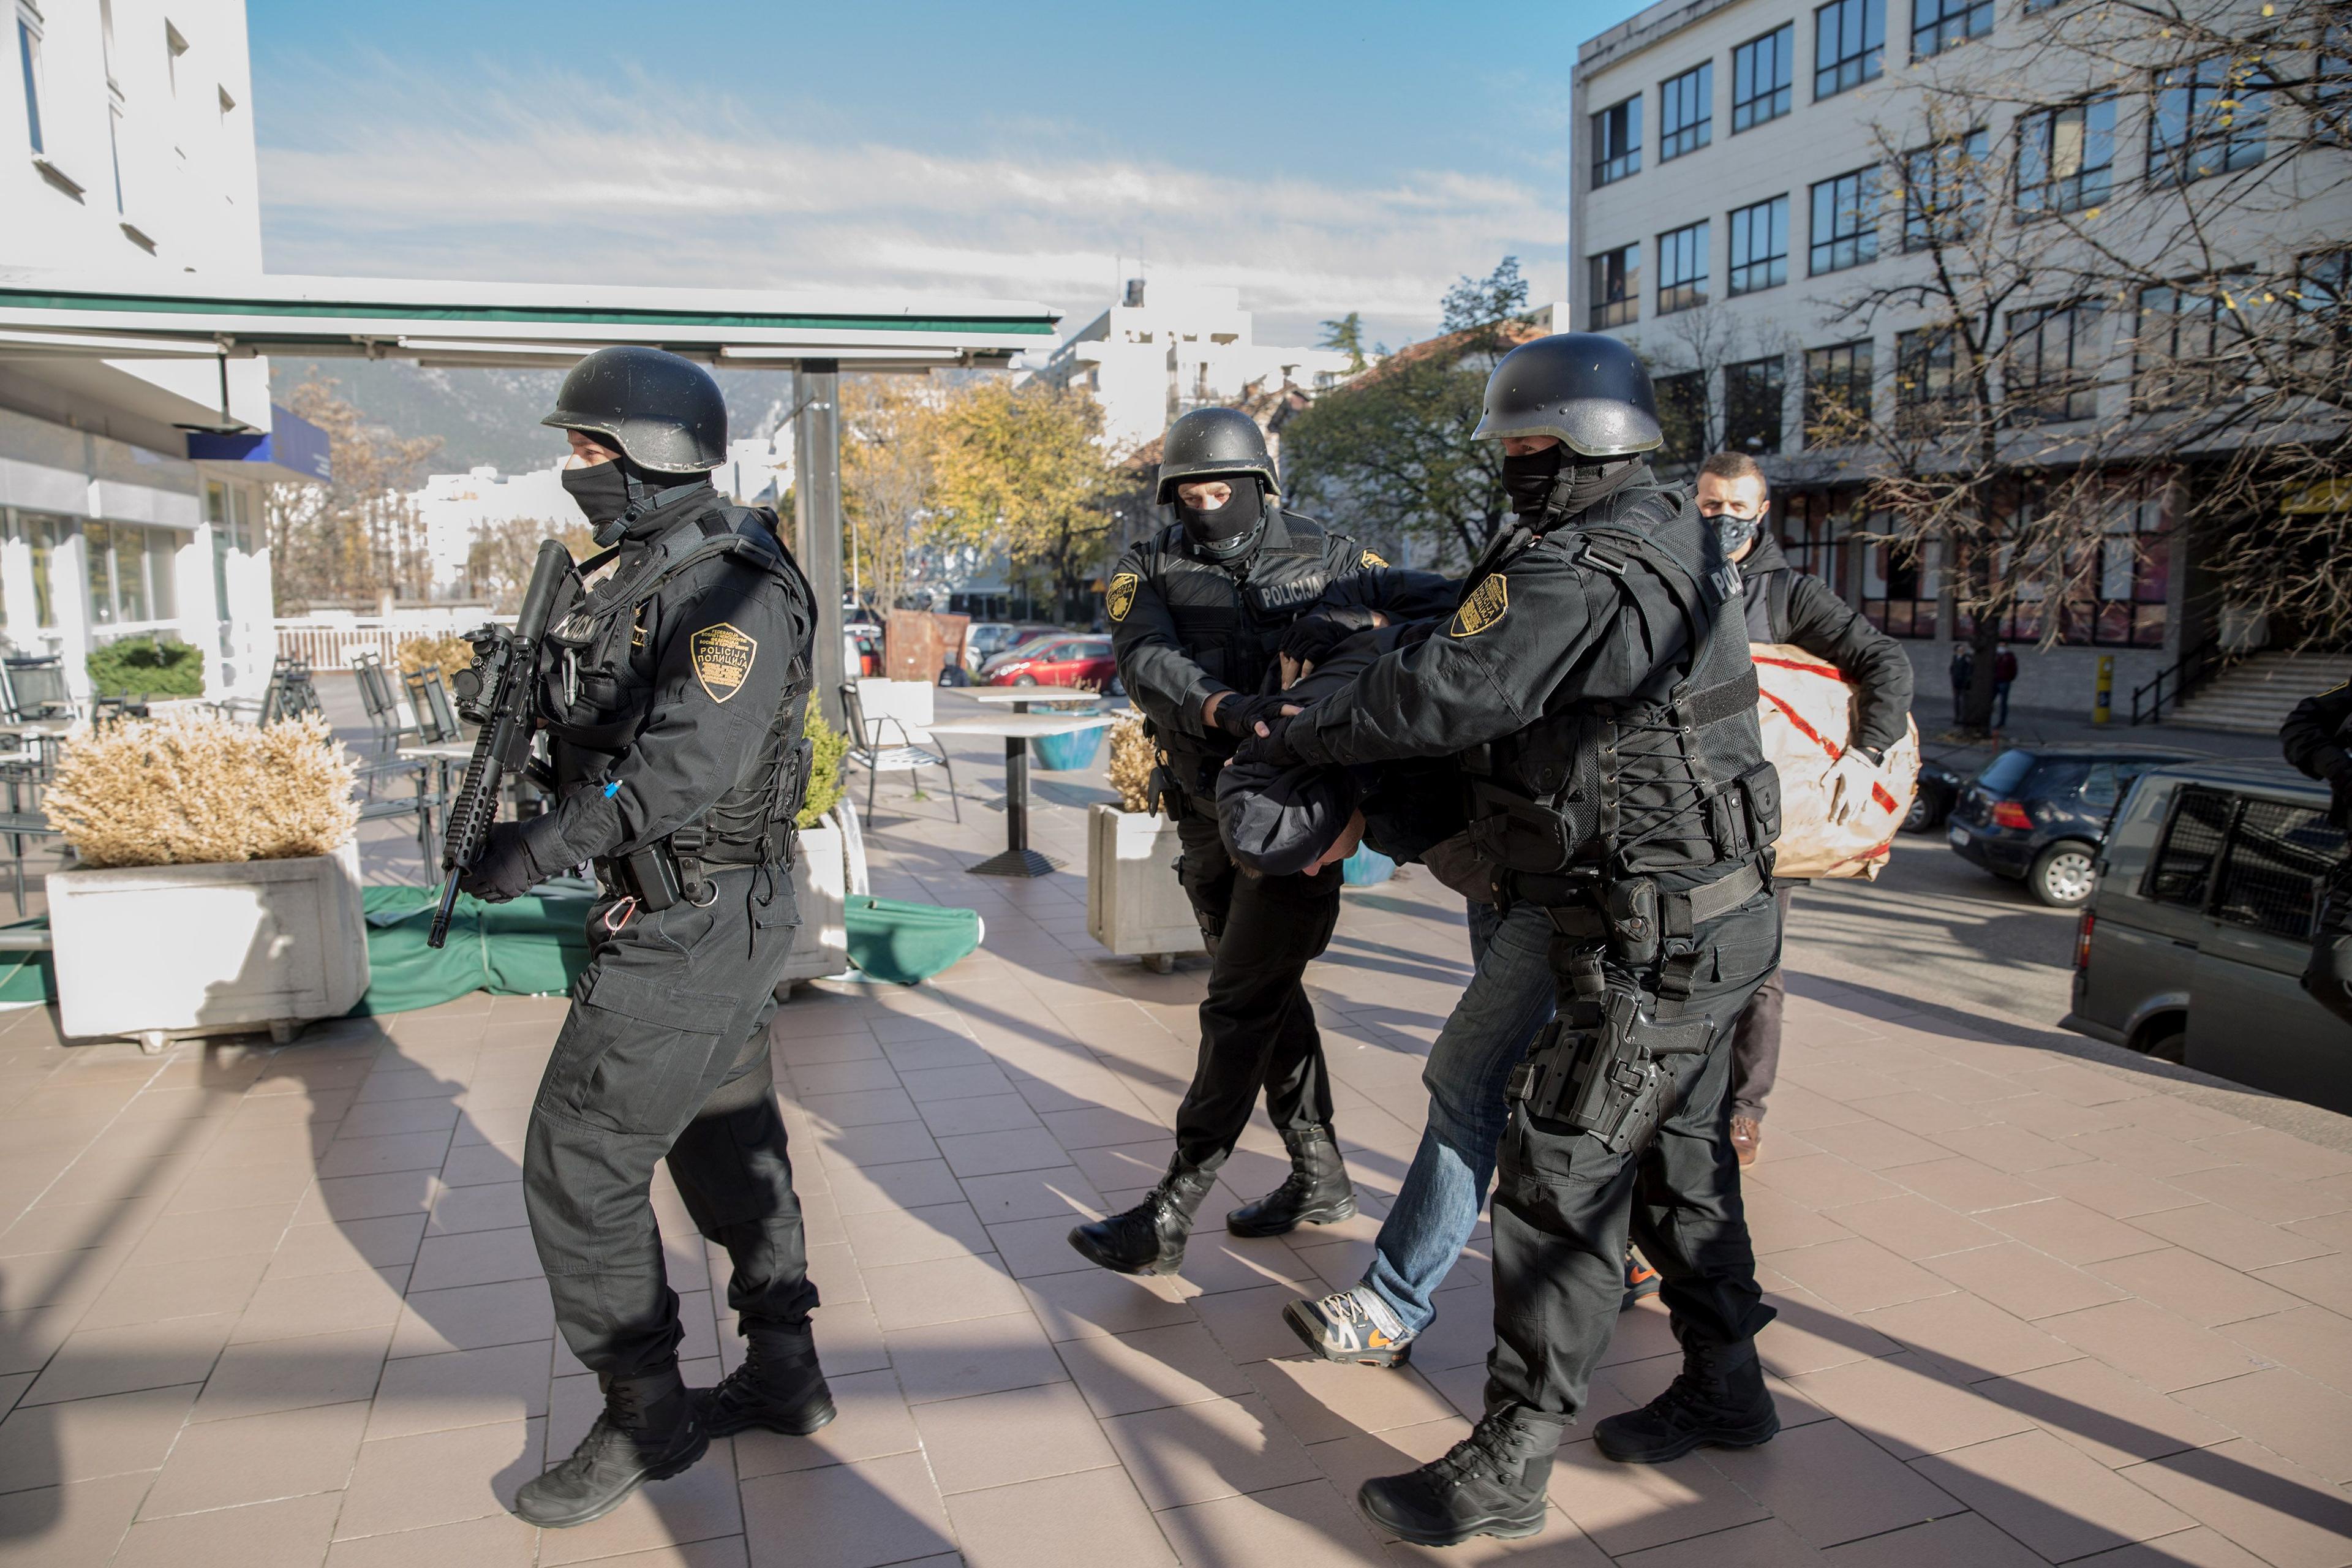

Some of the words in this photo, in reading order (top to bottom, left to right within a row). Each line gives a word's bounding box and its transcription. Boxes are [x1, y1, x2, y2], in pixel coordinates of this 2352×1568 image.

[1261, 576, 1323, 608] POLICIJA
[700, 646, 747, 661] POLICIJA
[698, 654, 747, 669] ПОЛИЦИЈА
